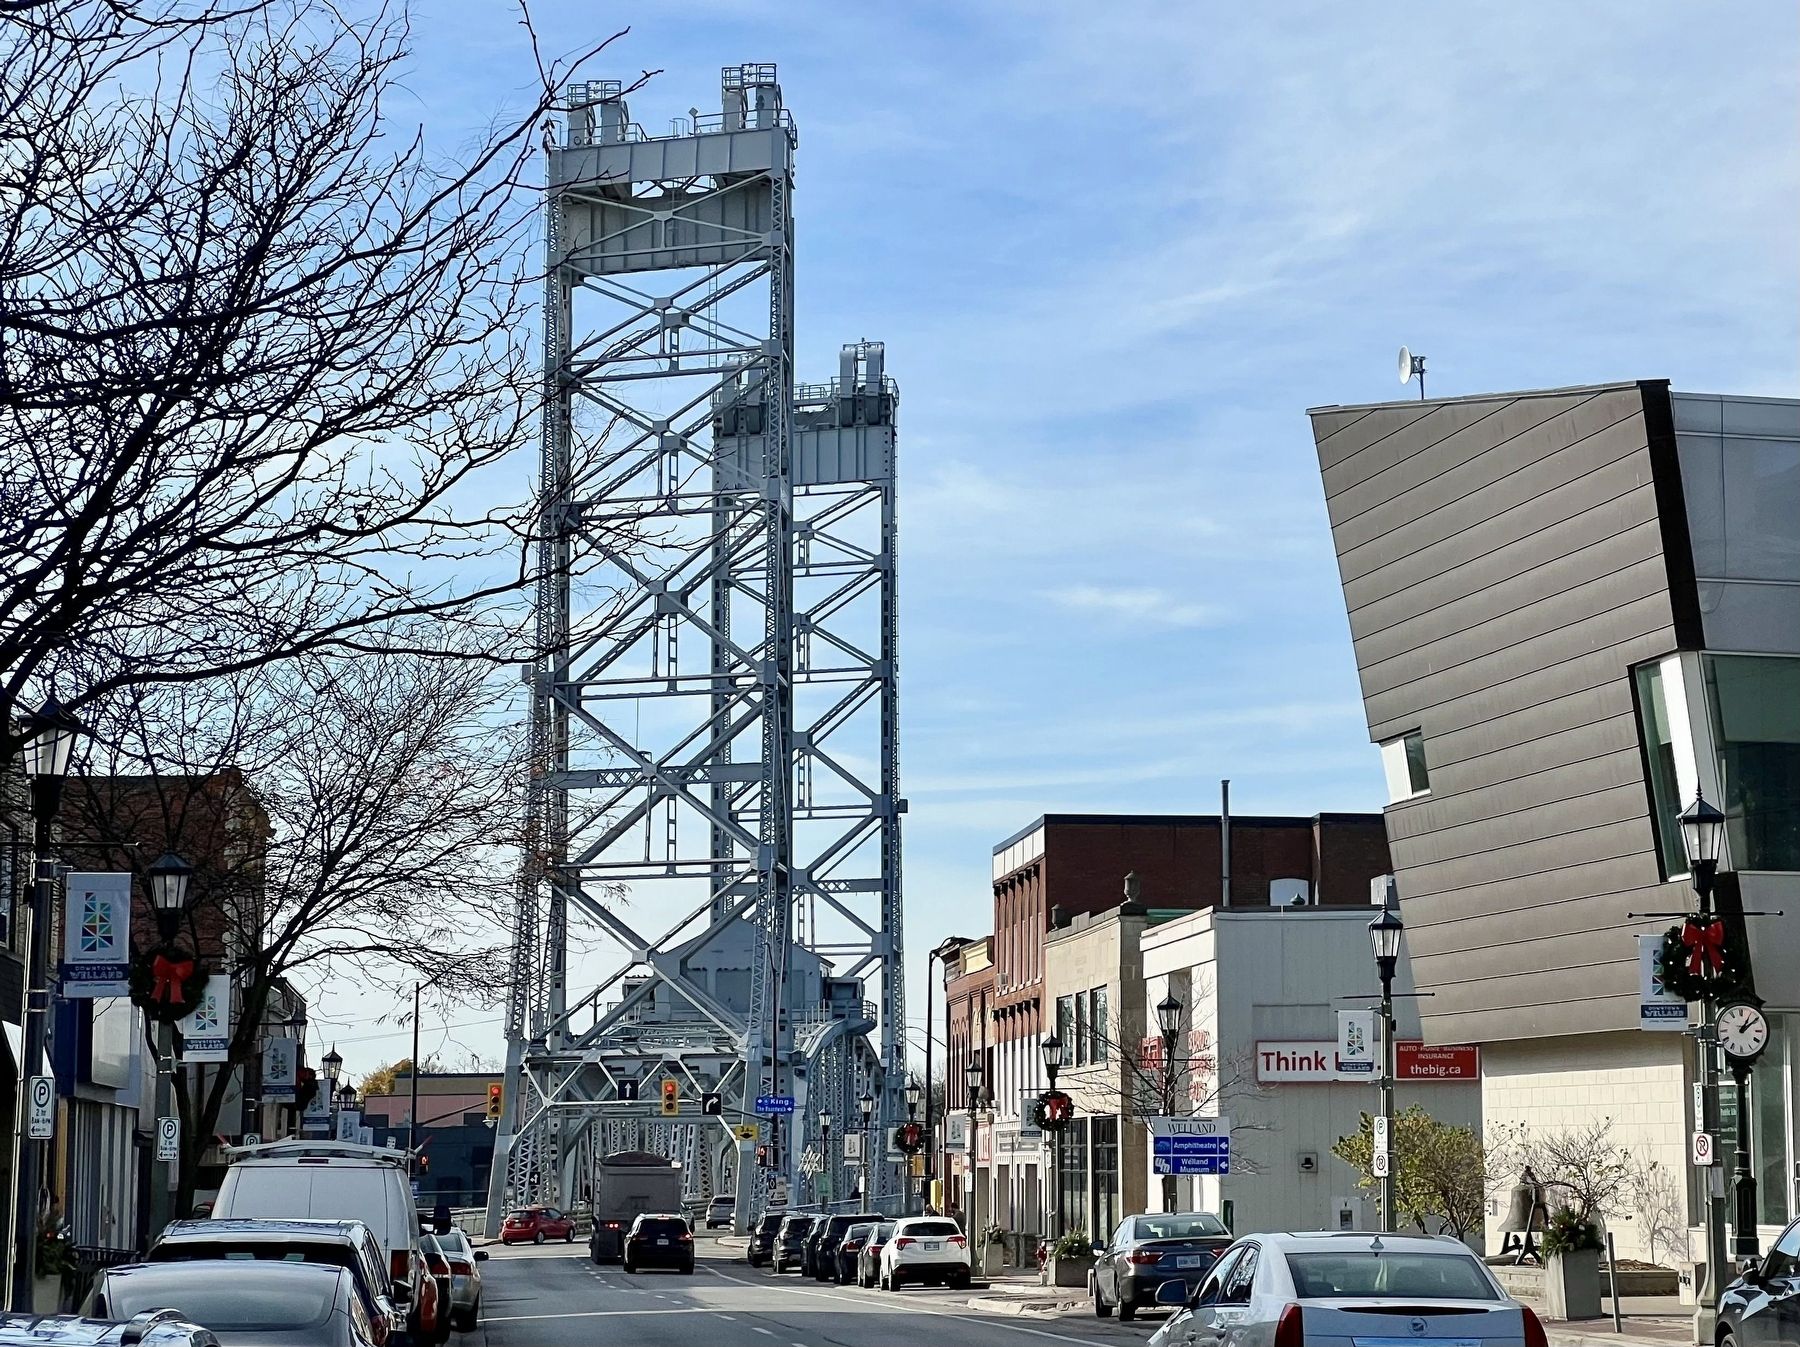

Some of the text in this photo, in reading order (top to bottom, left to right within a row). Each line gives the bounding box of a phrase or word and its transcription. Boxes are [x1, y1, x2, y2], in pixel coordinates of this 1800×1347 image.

[69, 970, 124, 980] WELLAND
[1260, 1050, 1327, 1071] Think
[1410, 1064, 1461, 1077] thebig.ca
[770, 1098, 789, 1106] King
[1167, 1123, 1216, 1134] WELLAND
[1173, 1142, 1217, 1150] Amphitheatre
